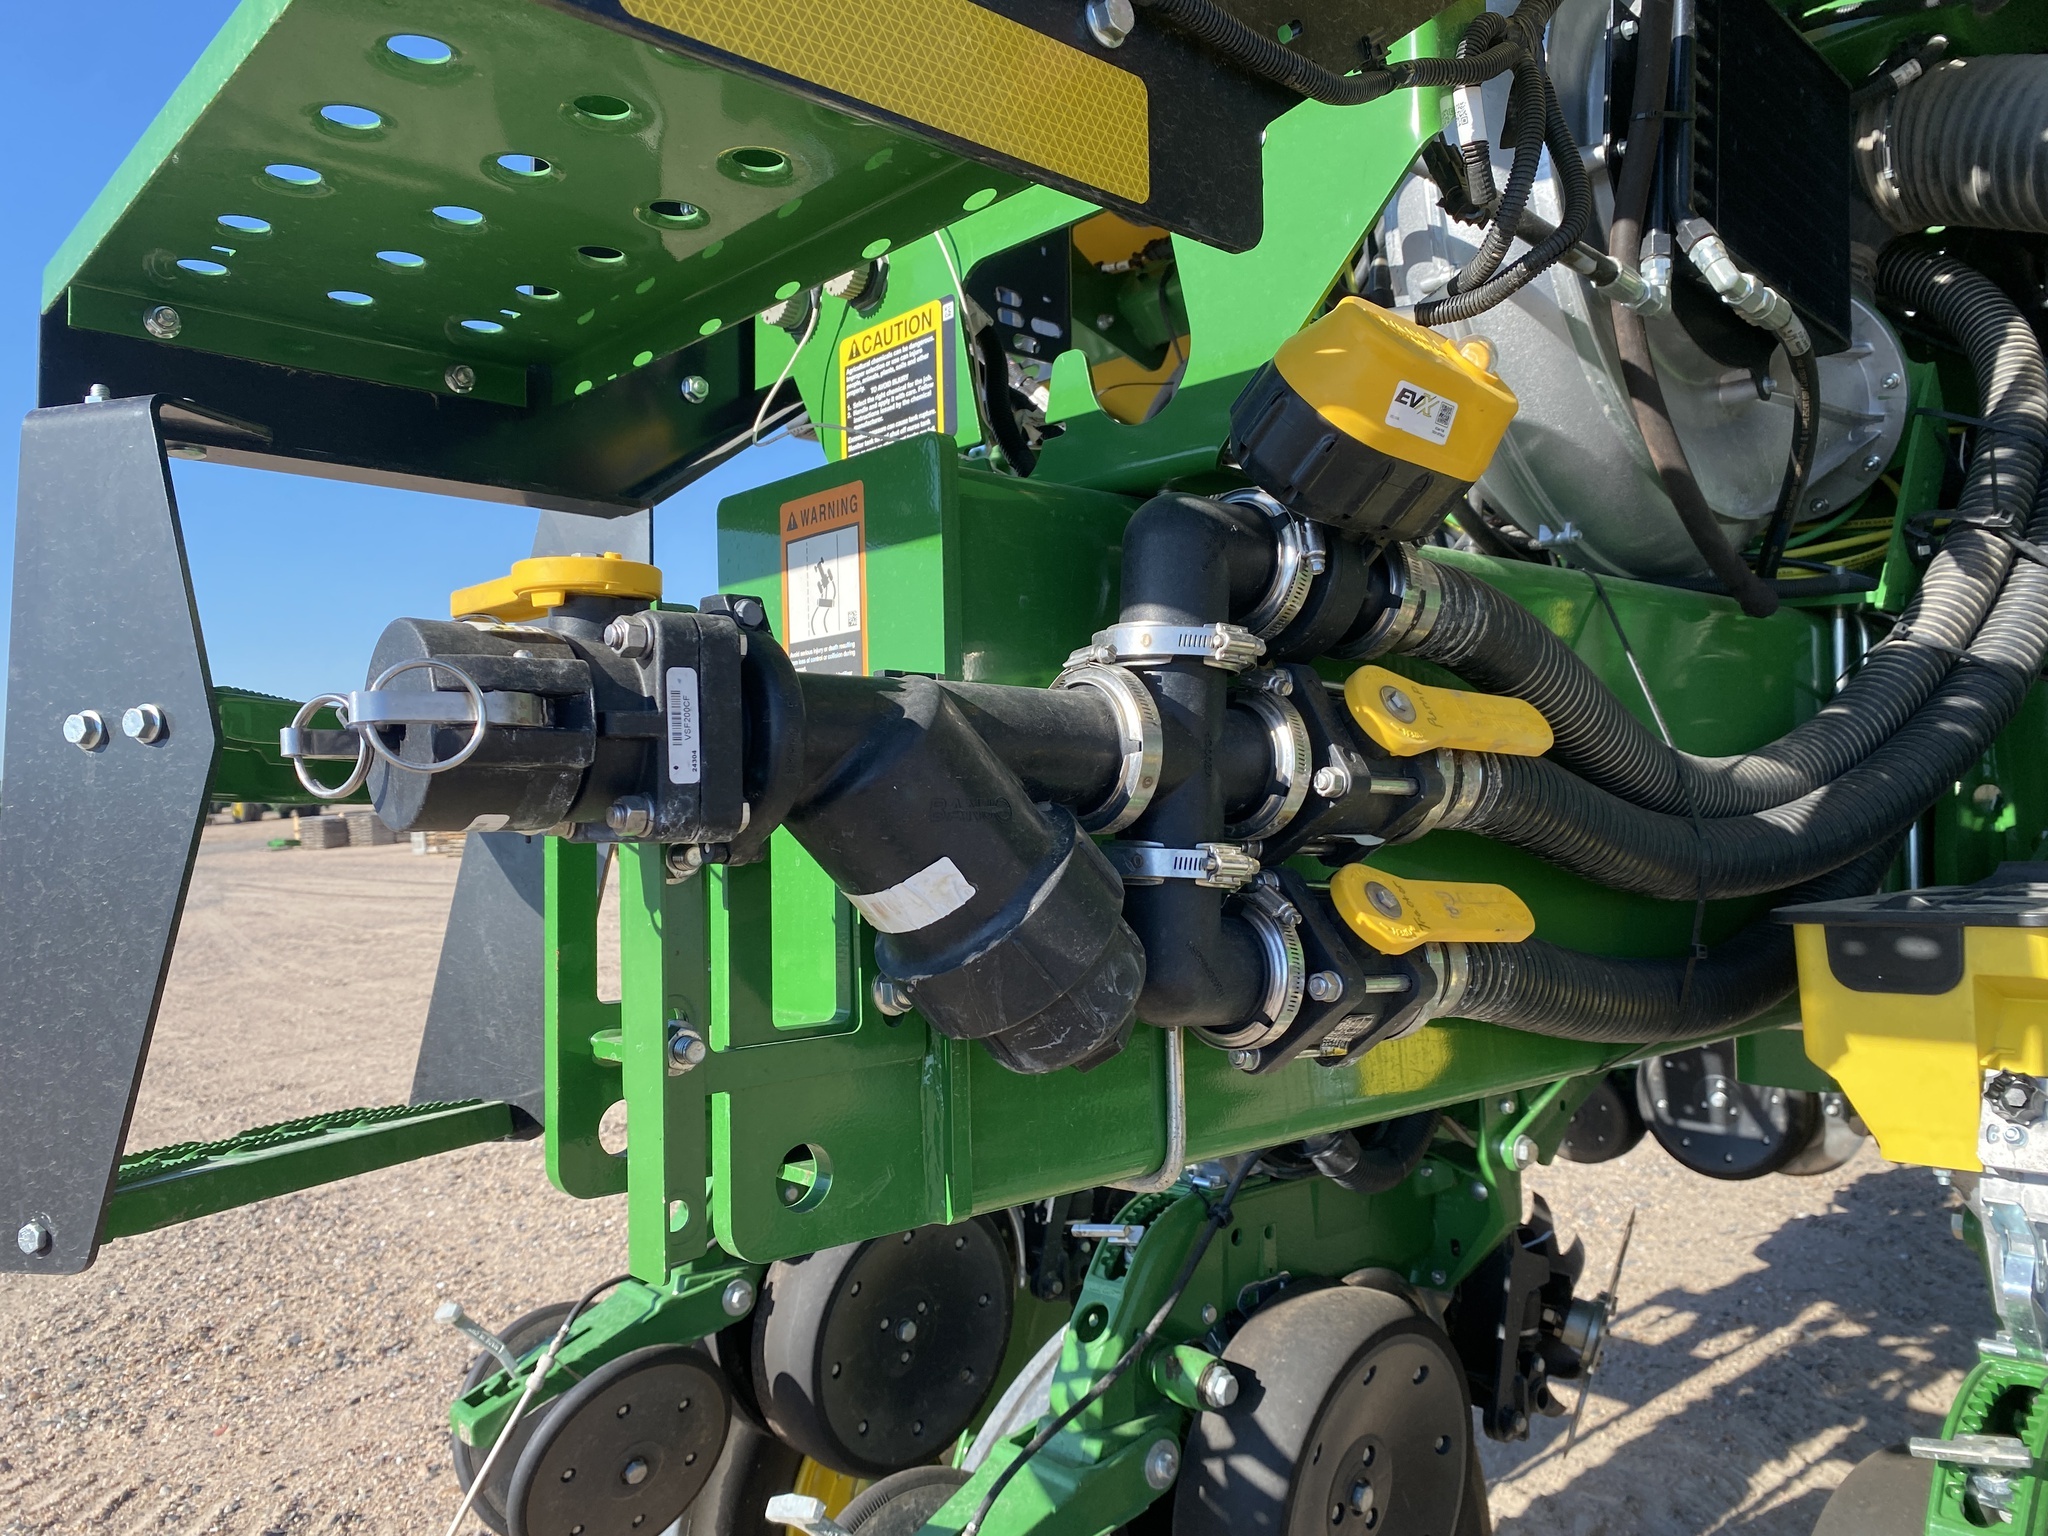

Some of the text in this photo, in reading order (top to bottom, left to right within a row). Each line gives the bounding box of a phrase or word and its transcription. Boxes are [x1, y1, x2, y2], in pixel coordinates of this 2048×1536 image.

[861, 309, 933, 354] CAUTION
[871, 352, 892, 364] chemicals
[853, 399, 866, 408] Select
[875, 391, 886, 401] right
[886, 384, 906, 396] chemical
[923, 374, 933, 384] job.
[878, 380, 891, 391] AVOID
[892, 374, 909, 385] INJURY
[878, 399, 890, 408] apply
[895, 392, 905, 401] with
[918, 382, 934, 392] Follow
[911, 390, 932, 402] chemical
[1394, 387, 1440, 418] EVX
[909, 414, 918, 422] tank
[800, 493, 858, 527] WARNING
[800, 649, 813, 657] serious
[683, 695, 691, 741] VSF200CF
